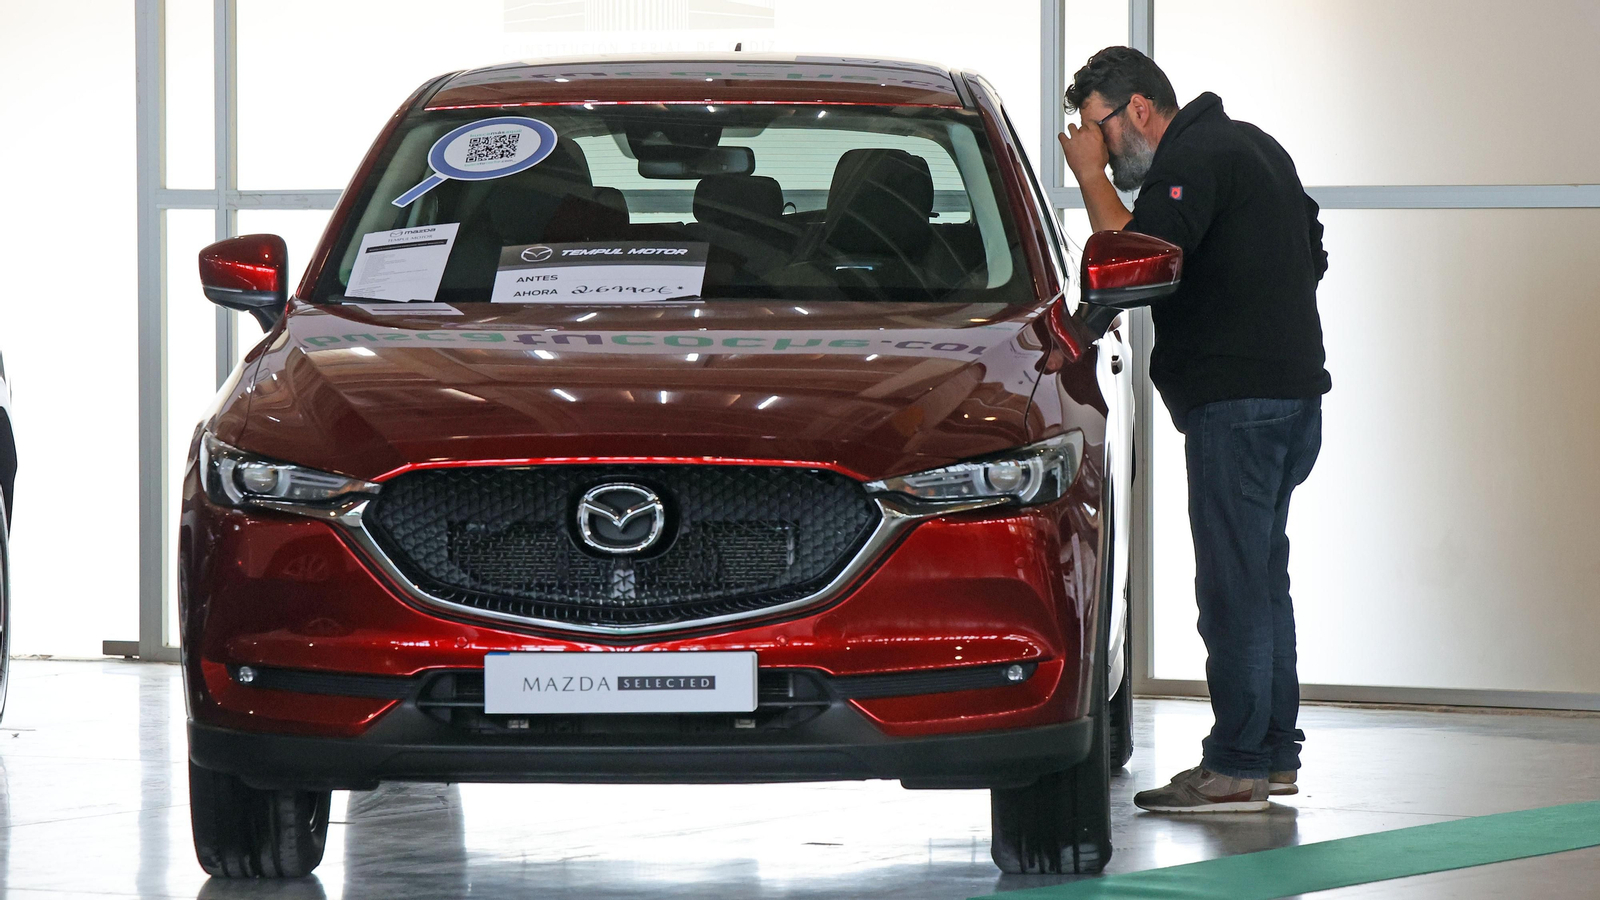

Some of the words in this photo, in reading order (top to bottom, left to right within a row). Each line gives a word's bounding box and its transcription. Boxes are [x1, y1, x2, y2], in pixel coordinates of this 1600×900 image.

[561, 248, 624, 257] TEMPUL
[627, 248, 689, 256] MOTOR
[516, 274, 558, 283] ANTES
[513, 288, 558, 298] AHORA
[522, 676, 611, 692] MAZDA
[623, 678, 710, 688] SELECTED
